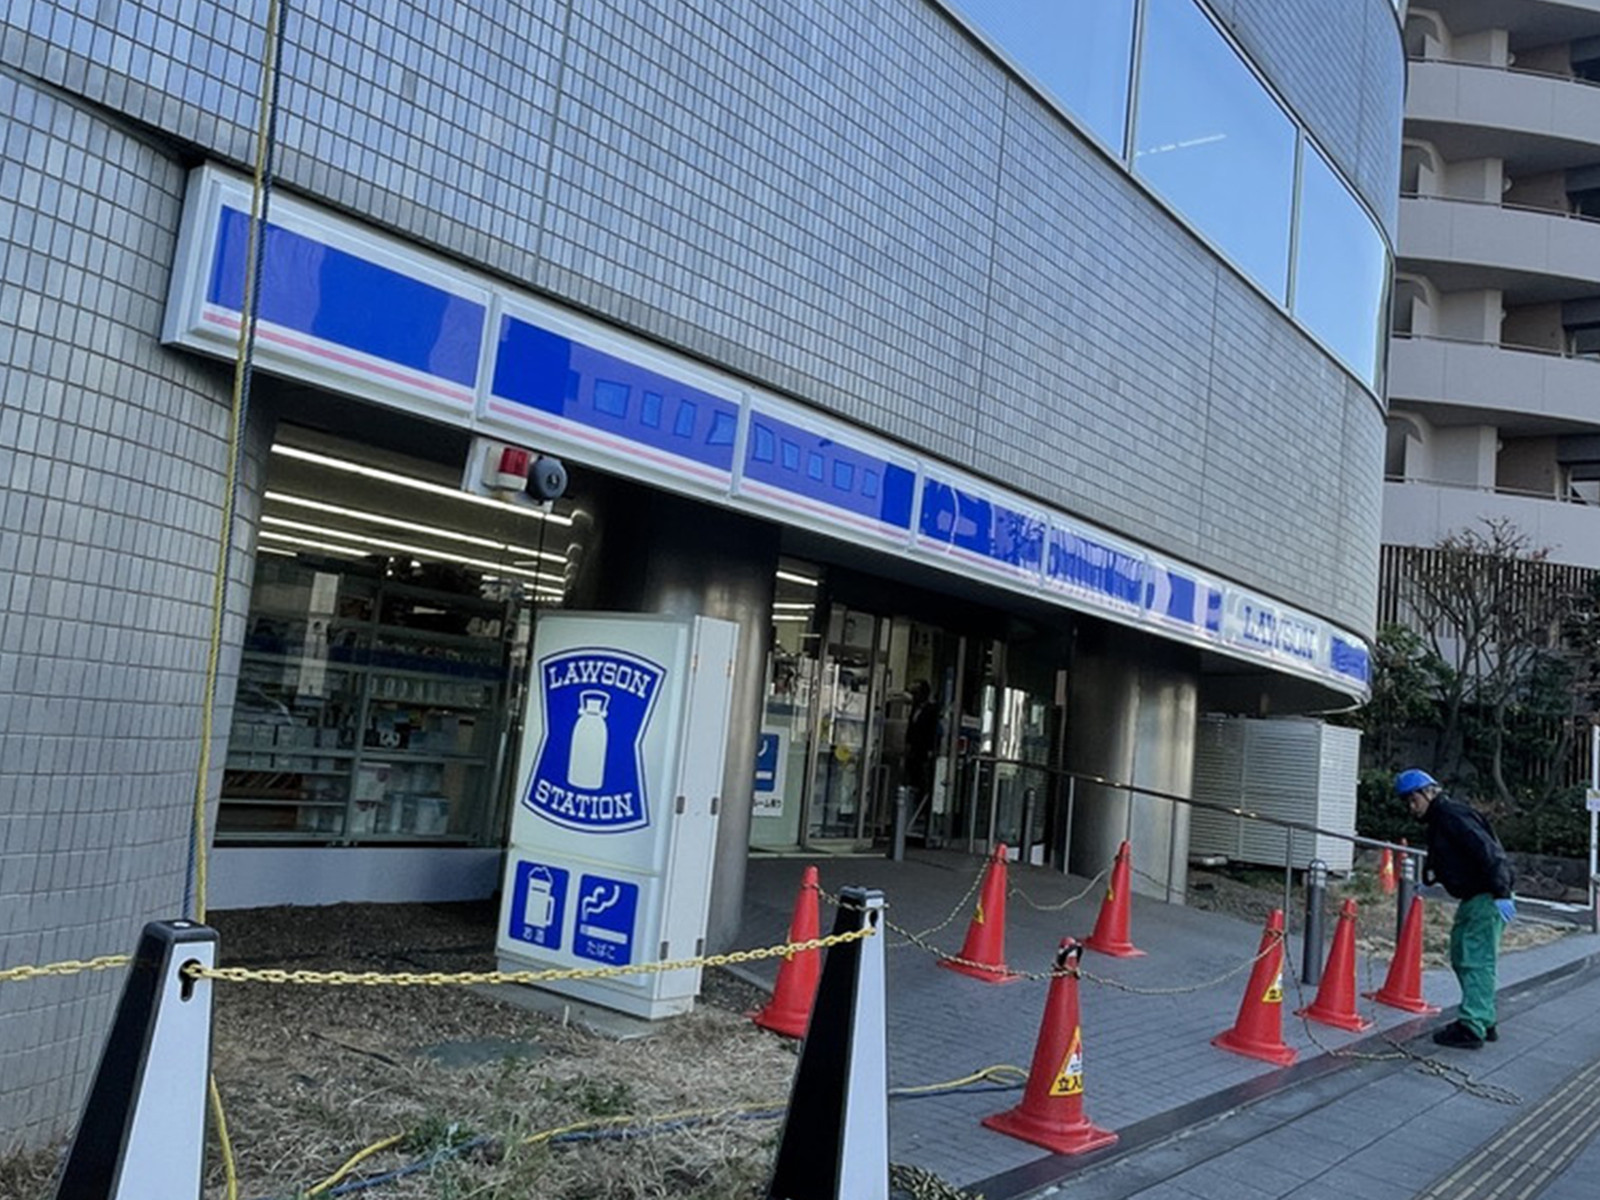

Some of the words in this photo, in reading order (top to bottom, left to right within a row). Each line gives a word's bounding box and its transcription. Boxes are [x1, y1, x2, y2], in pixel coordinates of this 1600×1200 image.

[1243, 606, 1315, 659] LAWSON
[549, 661, 651, 699] LAWSON
[534, 778, 634, 820] STATION
[586, 940, 616, 960] たばこ
